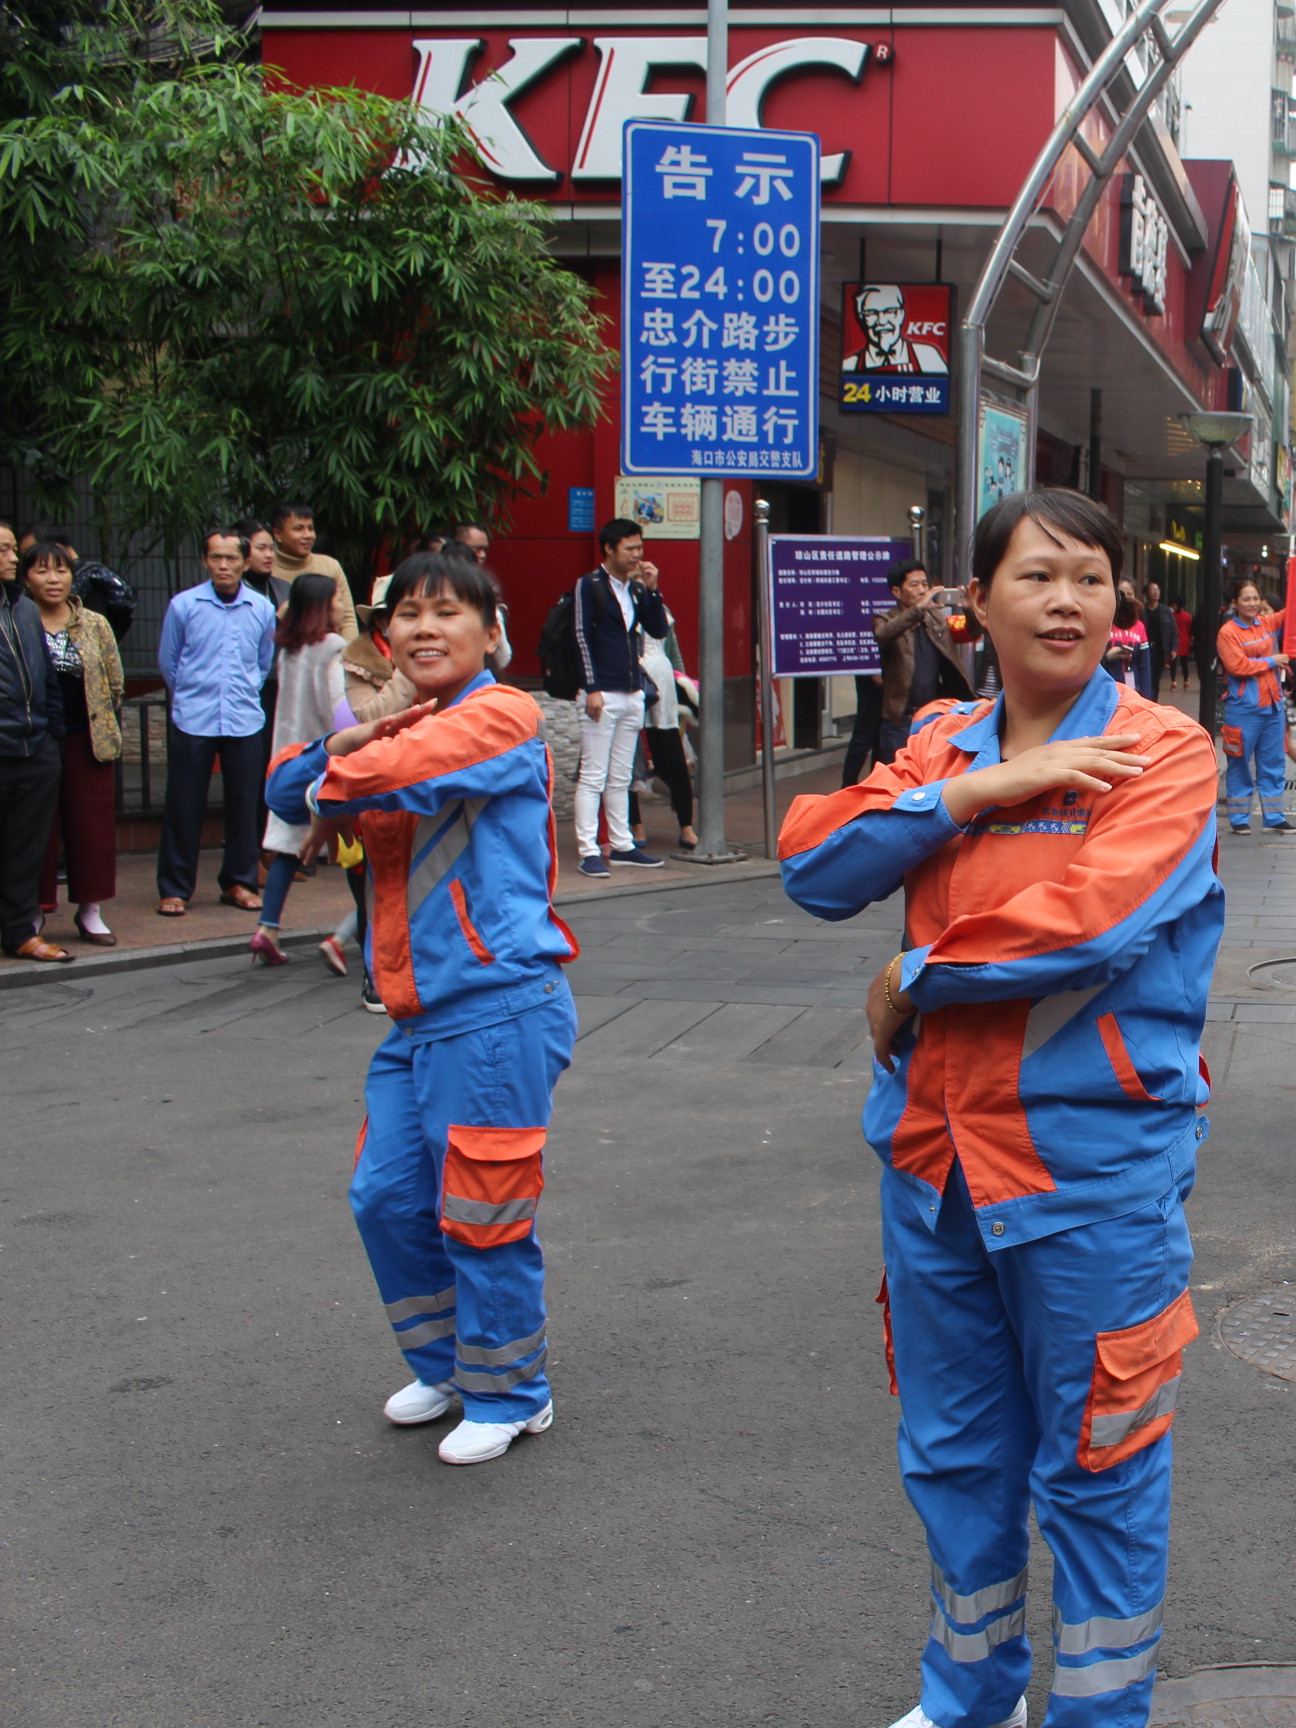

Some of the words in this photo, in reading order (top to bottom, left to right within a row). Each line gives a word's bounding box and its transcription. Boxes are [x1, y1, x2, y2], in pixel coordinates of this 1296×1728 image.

[388, 37, 873, 184] KFC
[655, 145, 794, 205] 告示
[706, 219, 800, 257] 7:00
[641, 262, 800, 304] 至24:00
[640, 307, 799, 351] 忠介路步
[906, 321, 946, 336] KFC
[640, 354, 799, 397] 行街禁止
[843, 383, 871, 403] 24
[875, 386, 941, 404] 小时营业
[640, 401, 799, 444] 车辆通行
[691, 449, 803, 469] 海口市公安局交警支队
